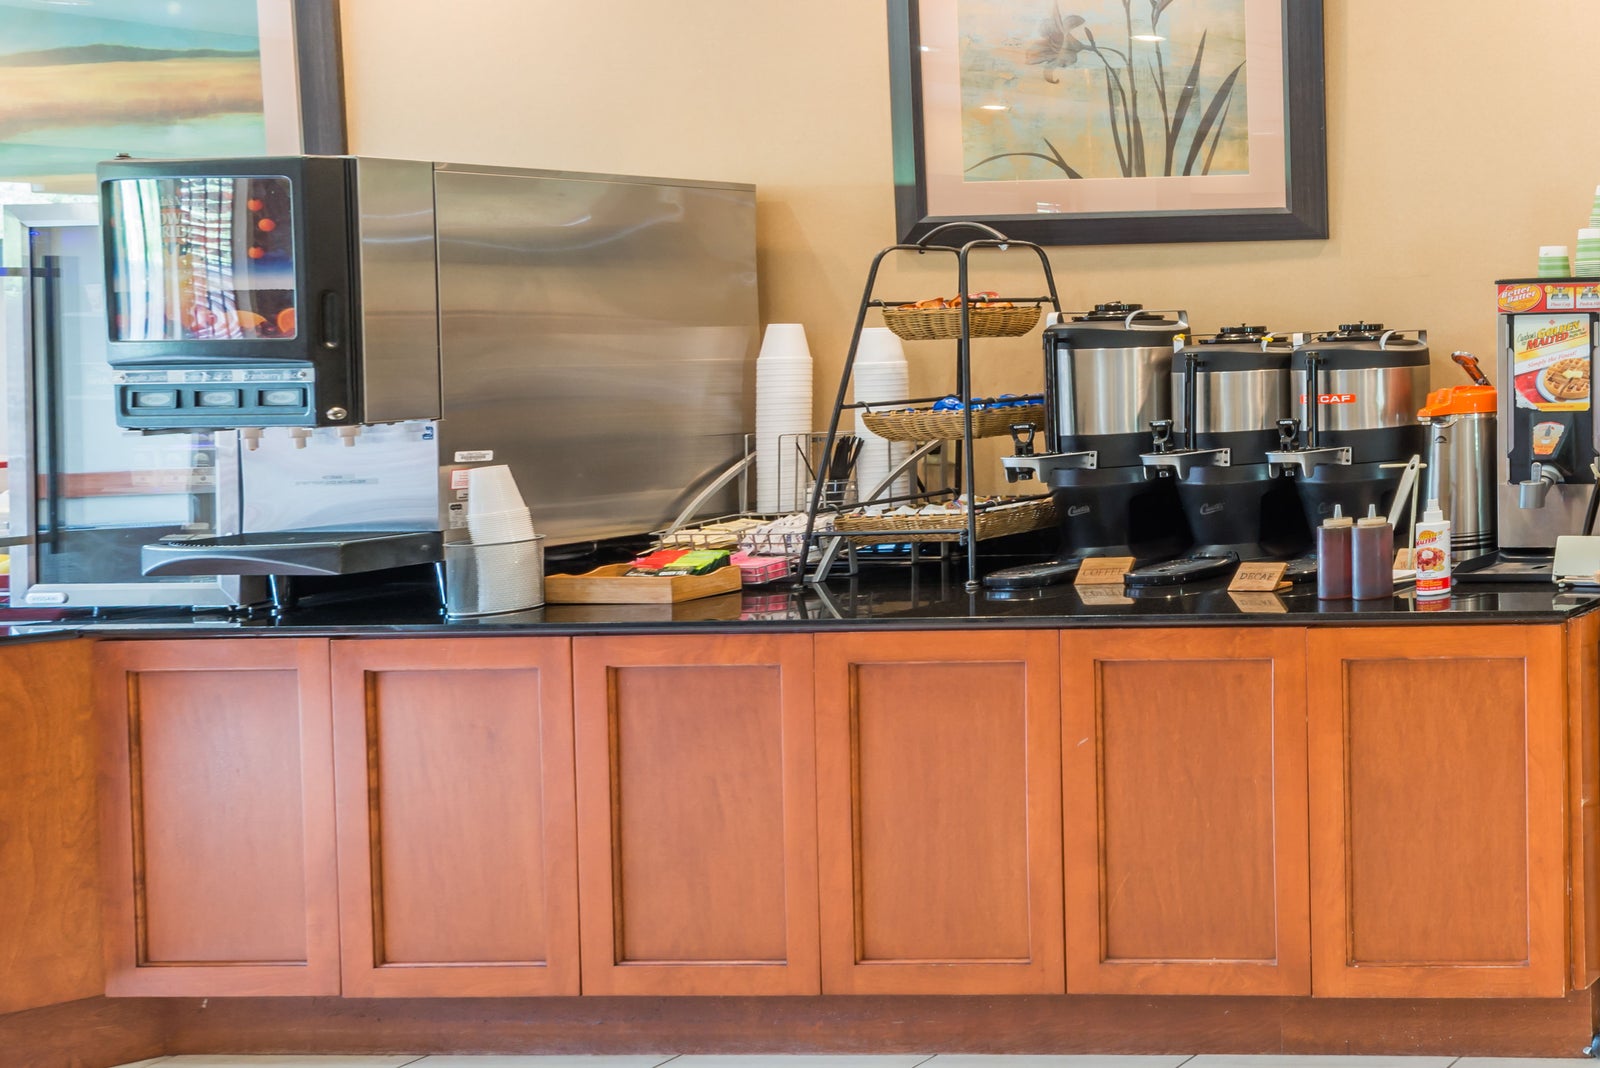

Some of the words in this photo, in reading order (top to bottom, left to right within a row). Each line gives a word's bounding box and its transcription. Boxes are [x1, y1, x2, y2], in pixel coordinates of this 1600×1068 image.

[1536, 320, 1580, 339] GOLDEN
[1526, 331, 1569, 350] MALTED
[1240, 572, 1275, 580] DECAF
